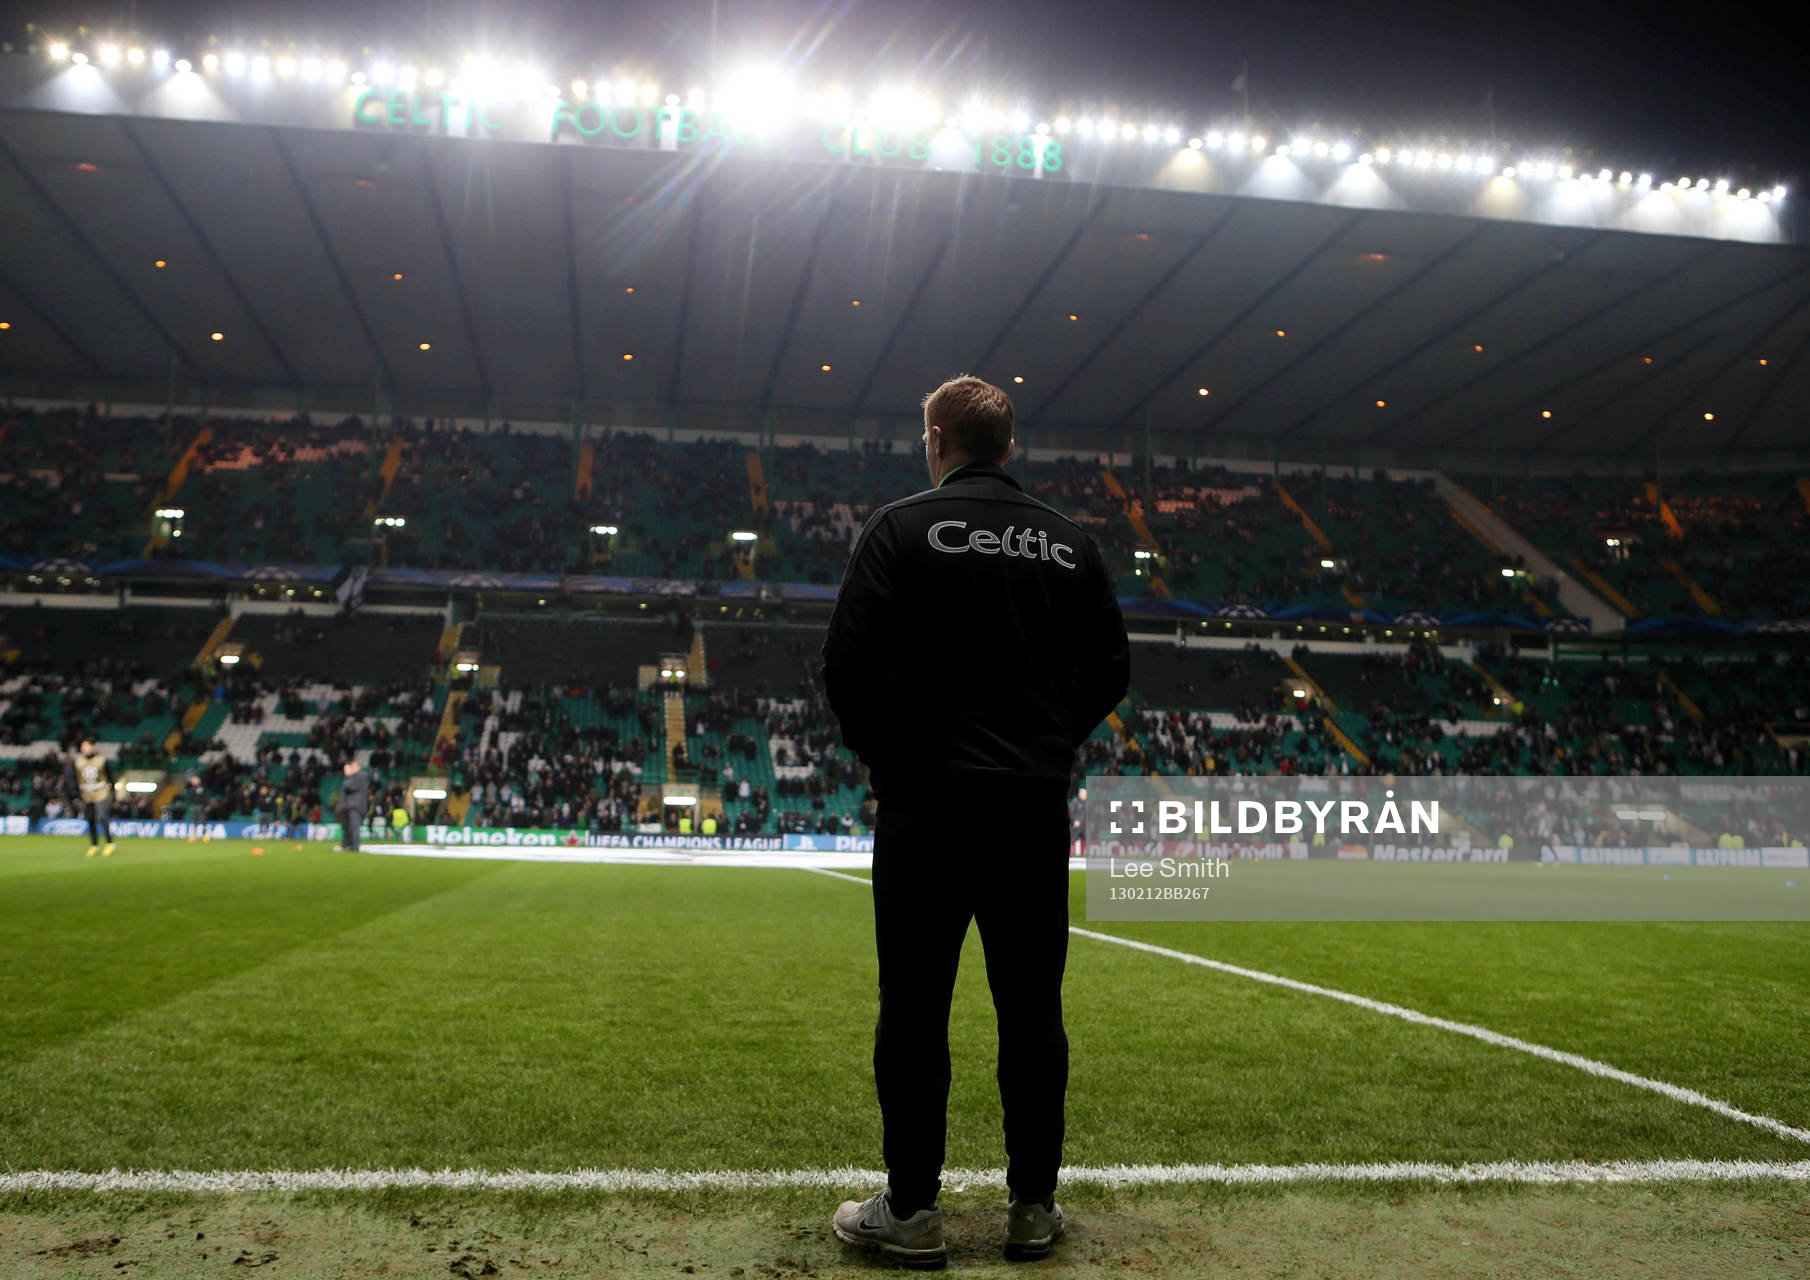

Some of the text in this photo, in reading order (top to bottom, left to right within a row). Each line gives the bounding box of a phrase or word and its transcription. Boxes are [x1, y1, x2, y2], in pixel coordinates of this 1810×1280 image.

[354, 89, 503, 130] CELTIC
[821, 123, 930, 160] CLUB
[972, 135, 1063, 173] 1888
[927, 520, 1076, 569] Celtic
[426, 825, 556, 846] Heineken
[633, 835, 721, 849] CHAMPIONS
[725, 837, 783, 850] LEAGUE
[835, 836, 875, 852] Pla
[1373, 844, 1509, 864] MasterCard
